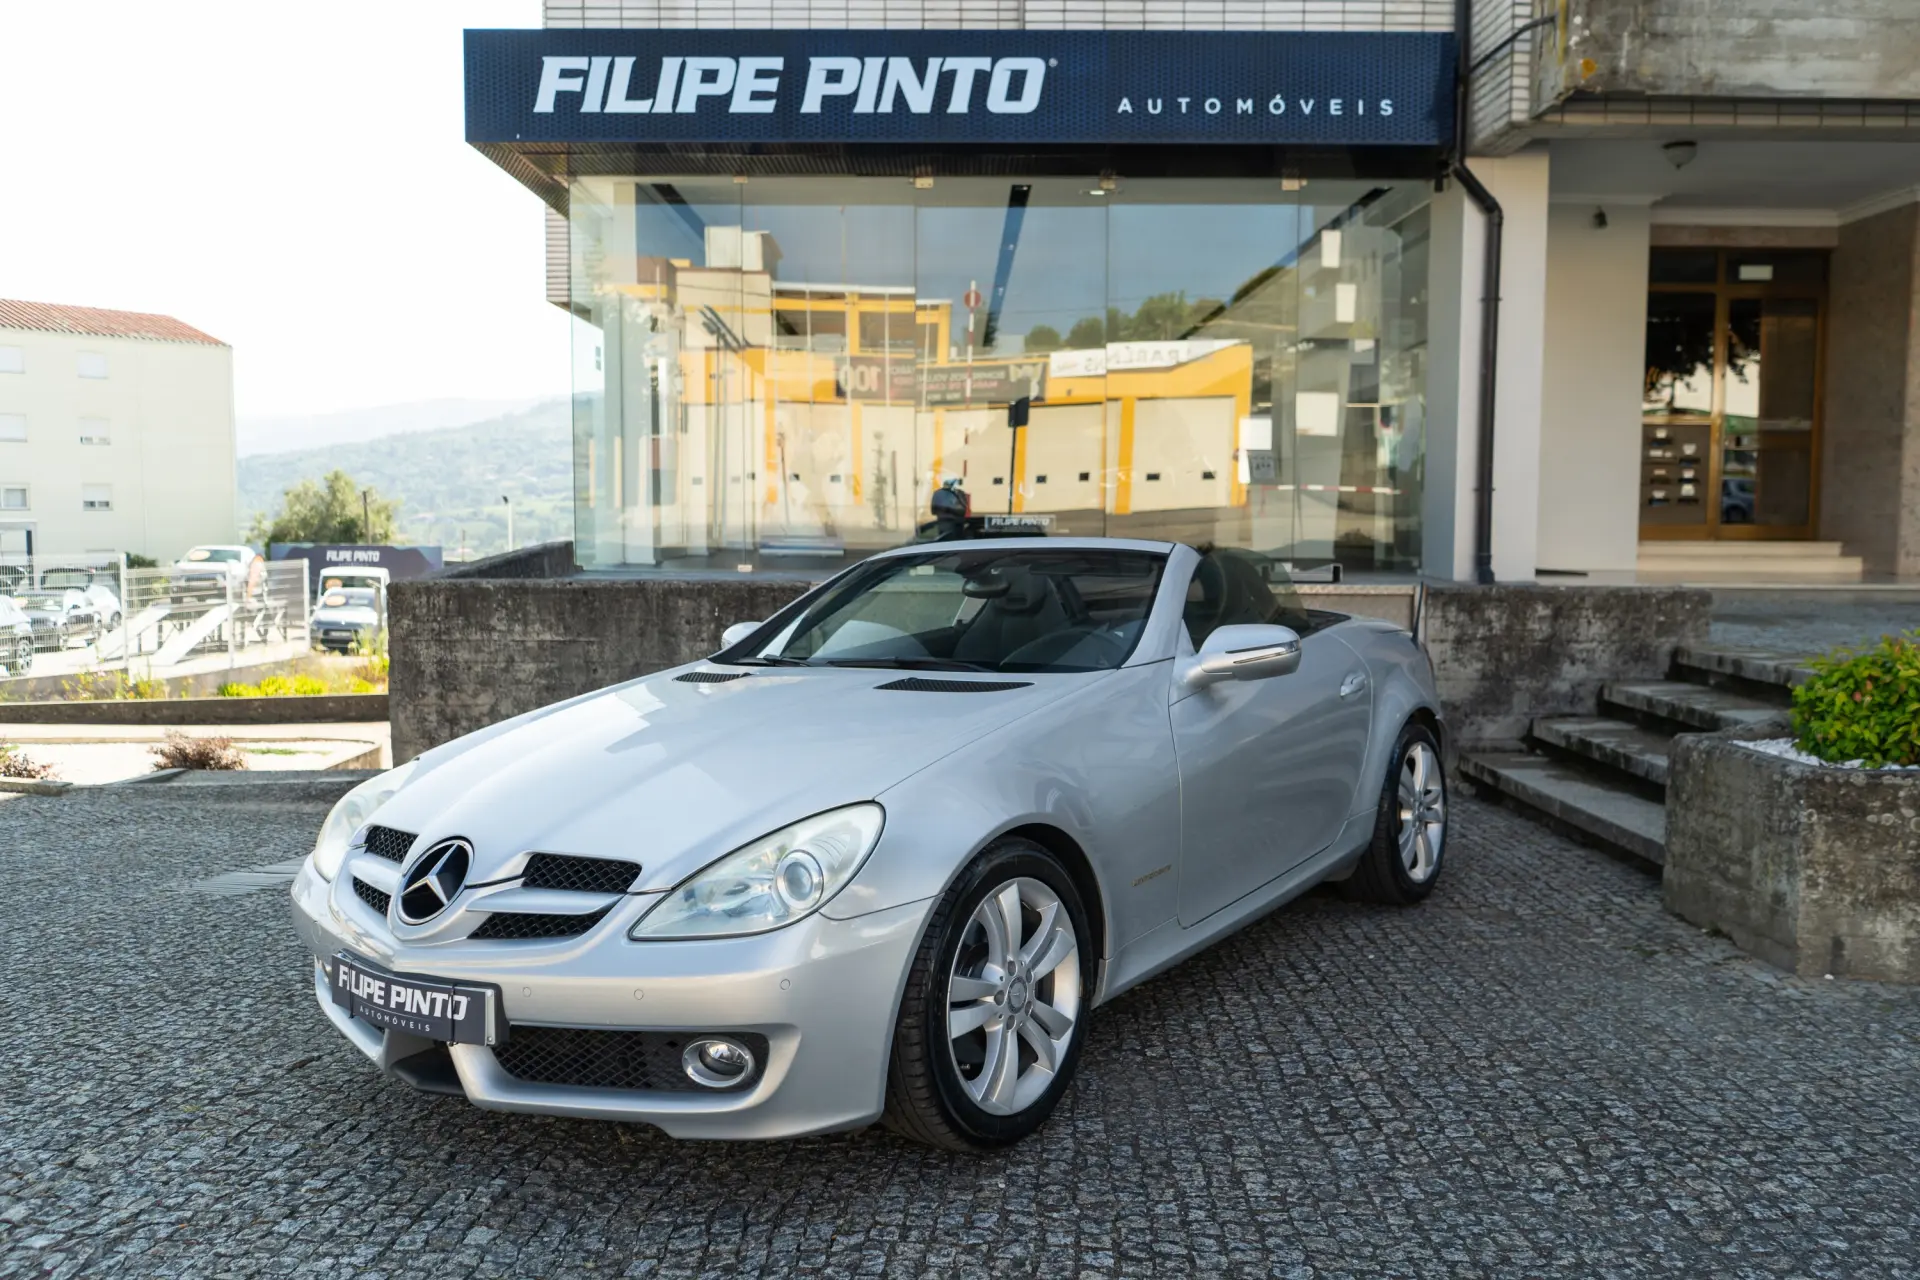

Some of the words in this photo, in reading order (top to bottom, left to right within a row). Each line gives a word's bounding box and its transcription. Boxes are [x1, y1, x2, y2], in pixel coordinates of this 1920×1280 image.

[533, 56, 784, 113] FILIPE
[1117, 94, 1393, 115] AUTOMÓVEIS
[326, 550, 352, 562] FILIPE
[353, 550, 380, 563] PINTO
[338, 964, 386, 1005] FILIPE
[360, 1005, 430, 1032] AUTOMÓVEIS
